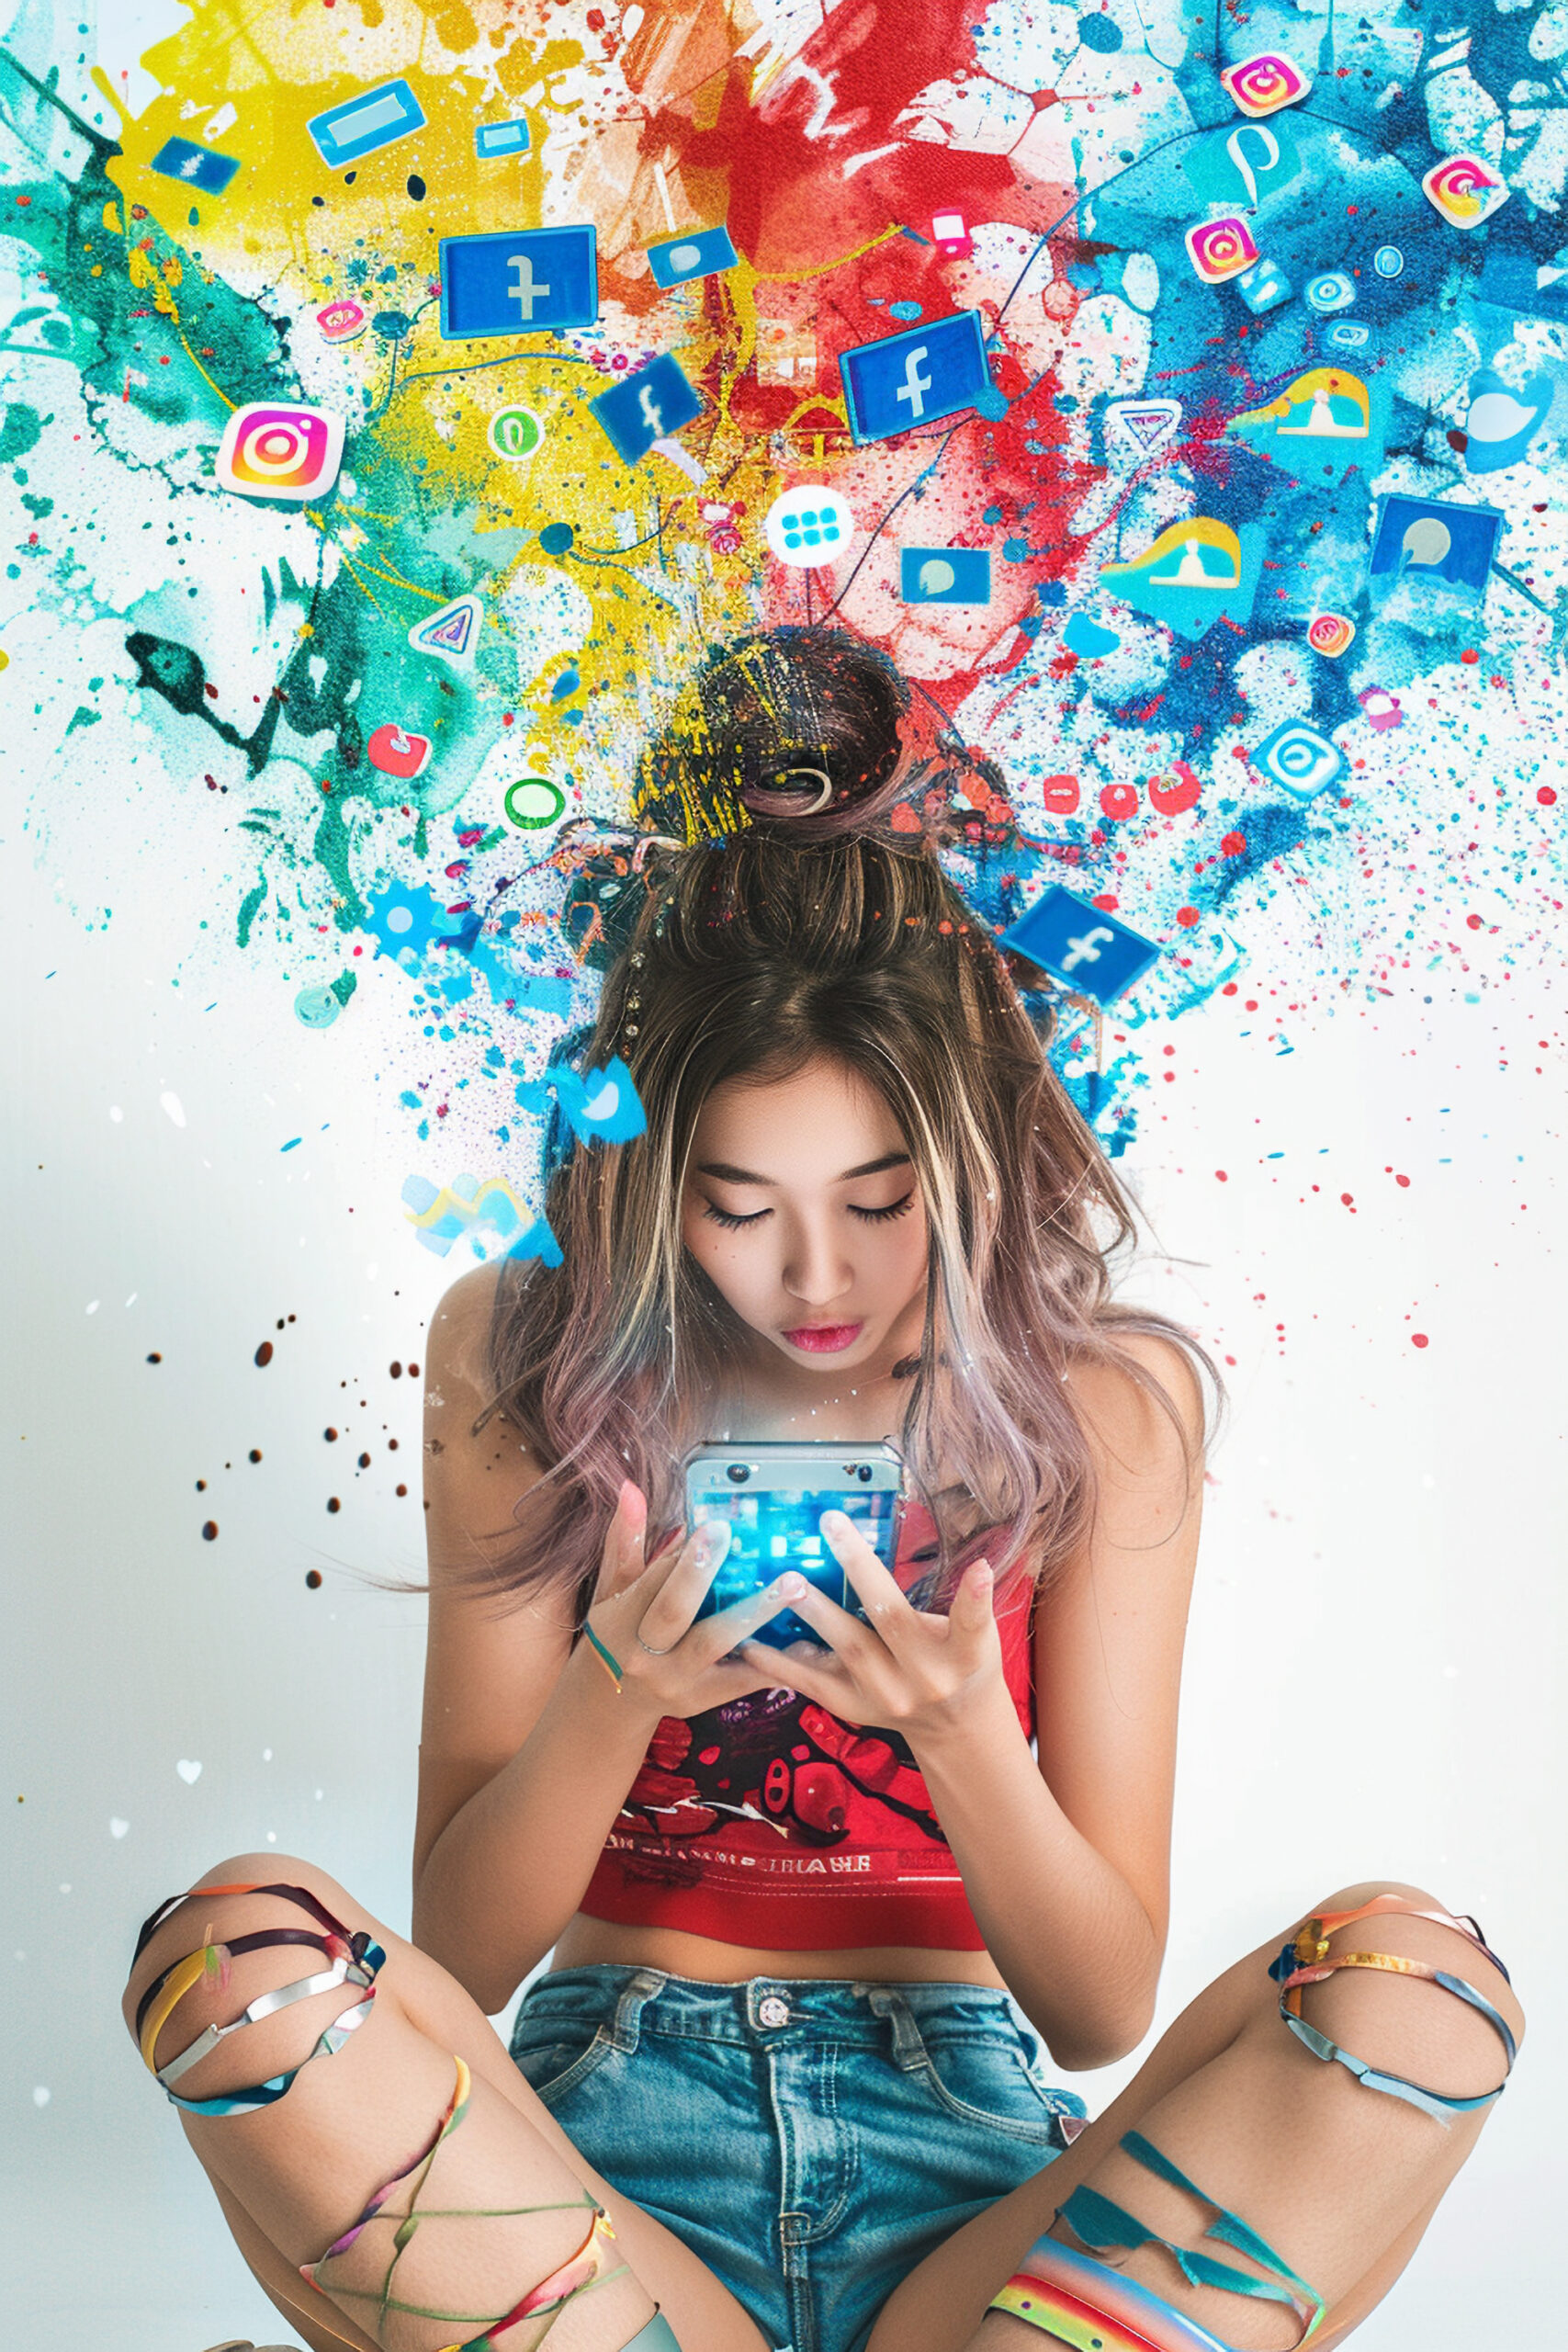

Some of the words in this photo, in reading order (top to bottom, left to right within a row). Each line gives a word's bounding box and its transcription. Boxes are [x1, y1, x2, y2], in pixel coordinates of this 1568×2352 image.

[897, 345, 932, 418] f
[638, 384, 664, 438] f
[1061, 926, 1114, 972] f
